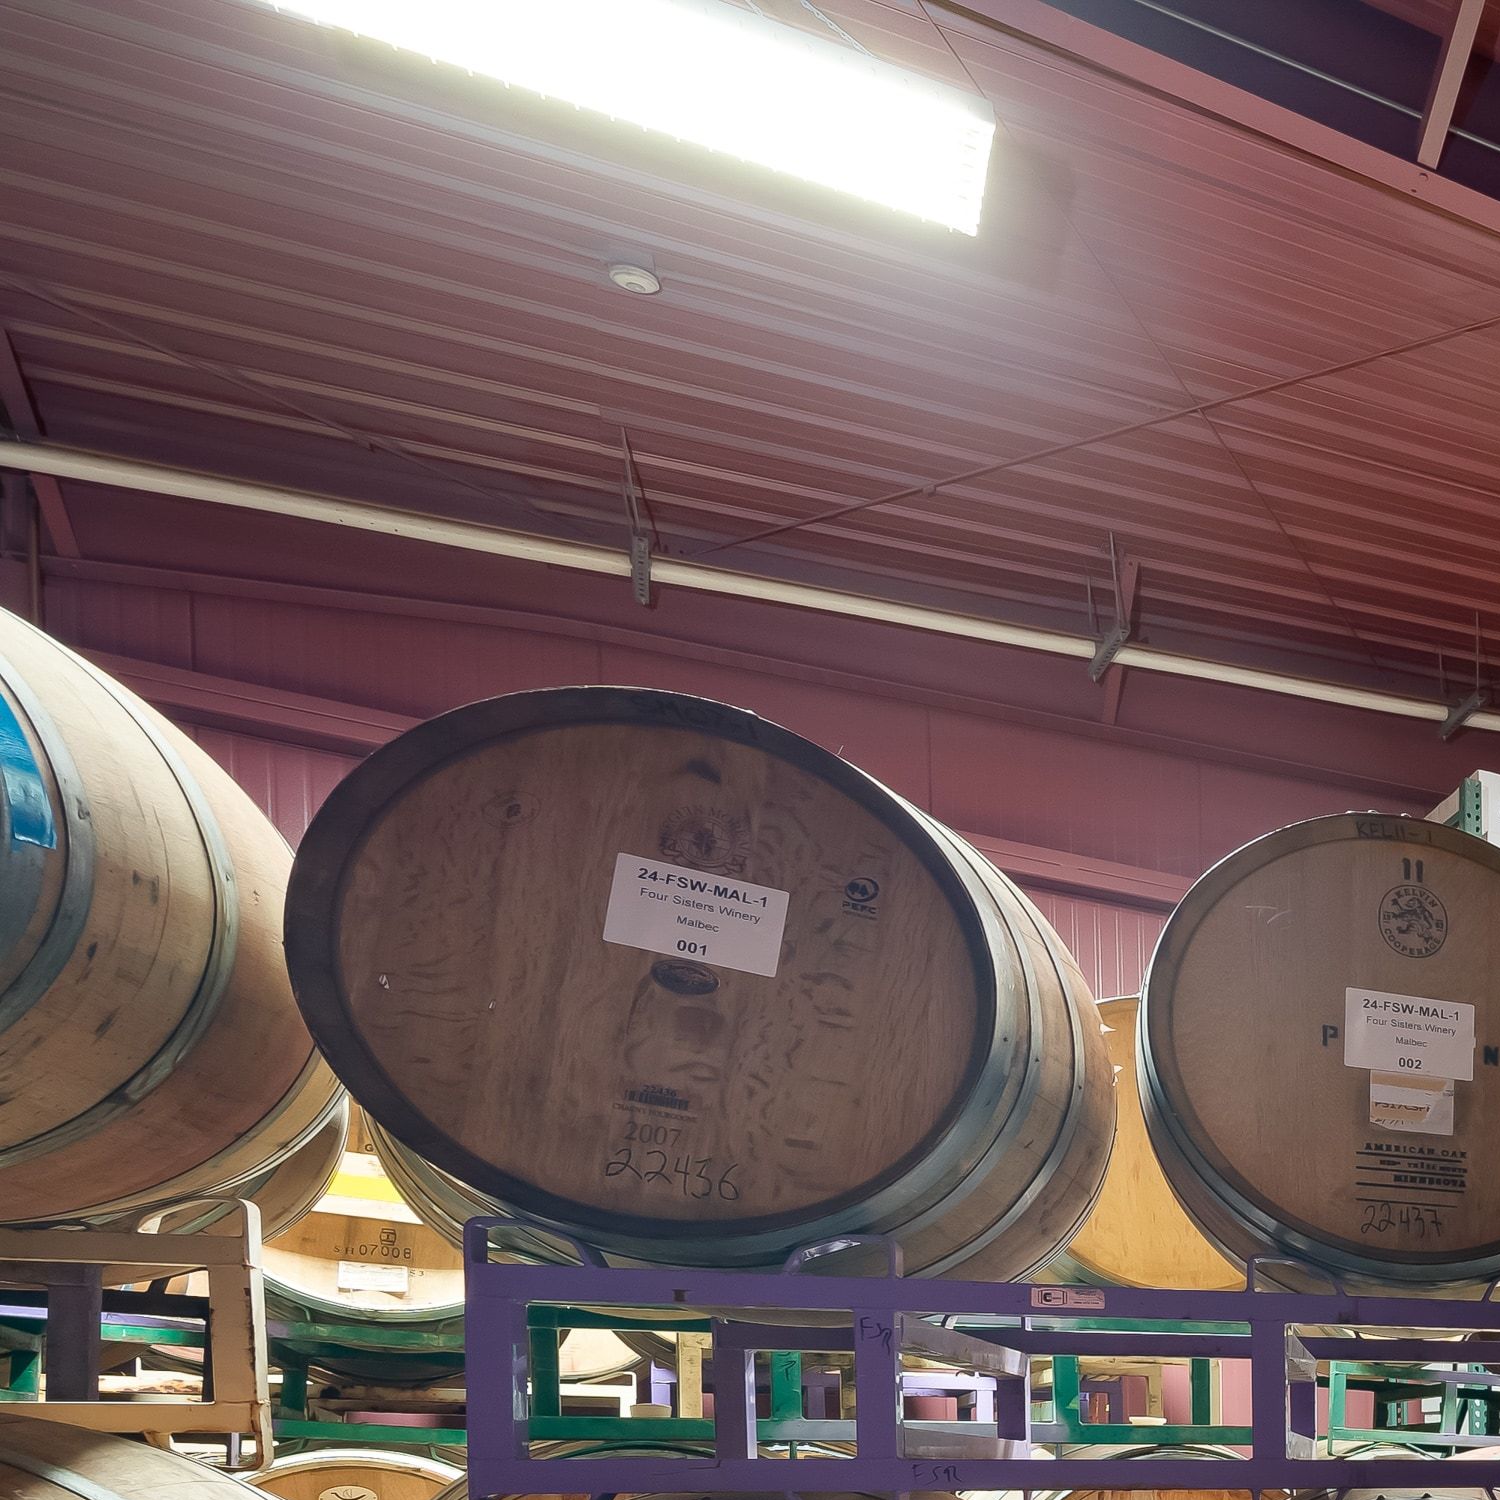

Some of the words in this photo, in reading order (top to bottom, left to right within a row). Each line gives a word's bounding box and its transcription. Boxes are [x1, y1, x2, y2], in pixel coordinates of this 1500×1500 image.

[637, 867, 769, 908] 24-FSW-MAL-1
[1395, 888, 1438, 907] KELVIN
[639, 887, 669, 902] Four
[672, 894, 715, 913] Sisters
[718, 905, 761, 925] Winery
[676, 915, 720, 933] Malbec
[676, 939, 708, 957] 001
[1362, 998, 1460, 1021] 24-FSW-MAL-1
[1322, 1025, 1338, 1047] P
[1365, 1015, 1388, 1028] Four
[1390, 1018, 1422, 1033] Sisters
[1424, 1024, 1457, 1037] Winery
[1395, 1035, 1428, 1049] Malbec
[1398, 1057, 1422, 1070] 002
[1483, 1046, 1499, 1066] N
[624, 1121, 682, 1147] 2007
[1364, 1143, 1435, 1155] AMERICAN
[1440, 1149, 1468, 1159] OAK
[606, 1148, 740, 1201] 22436
[1360, 1204, 1444, 1237] 22437
[359, 1244, 412, 1260] 07008
